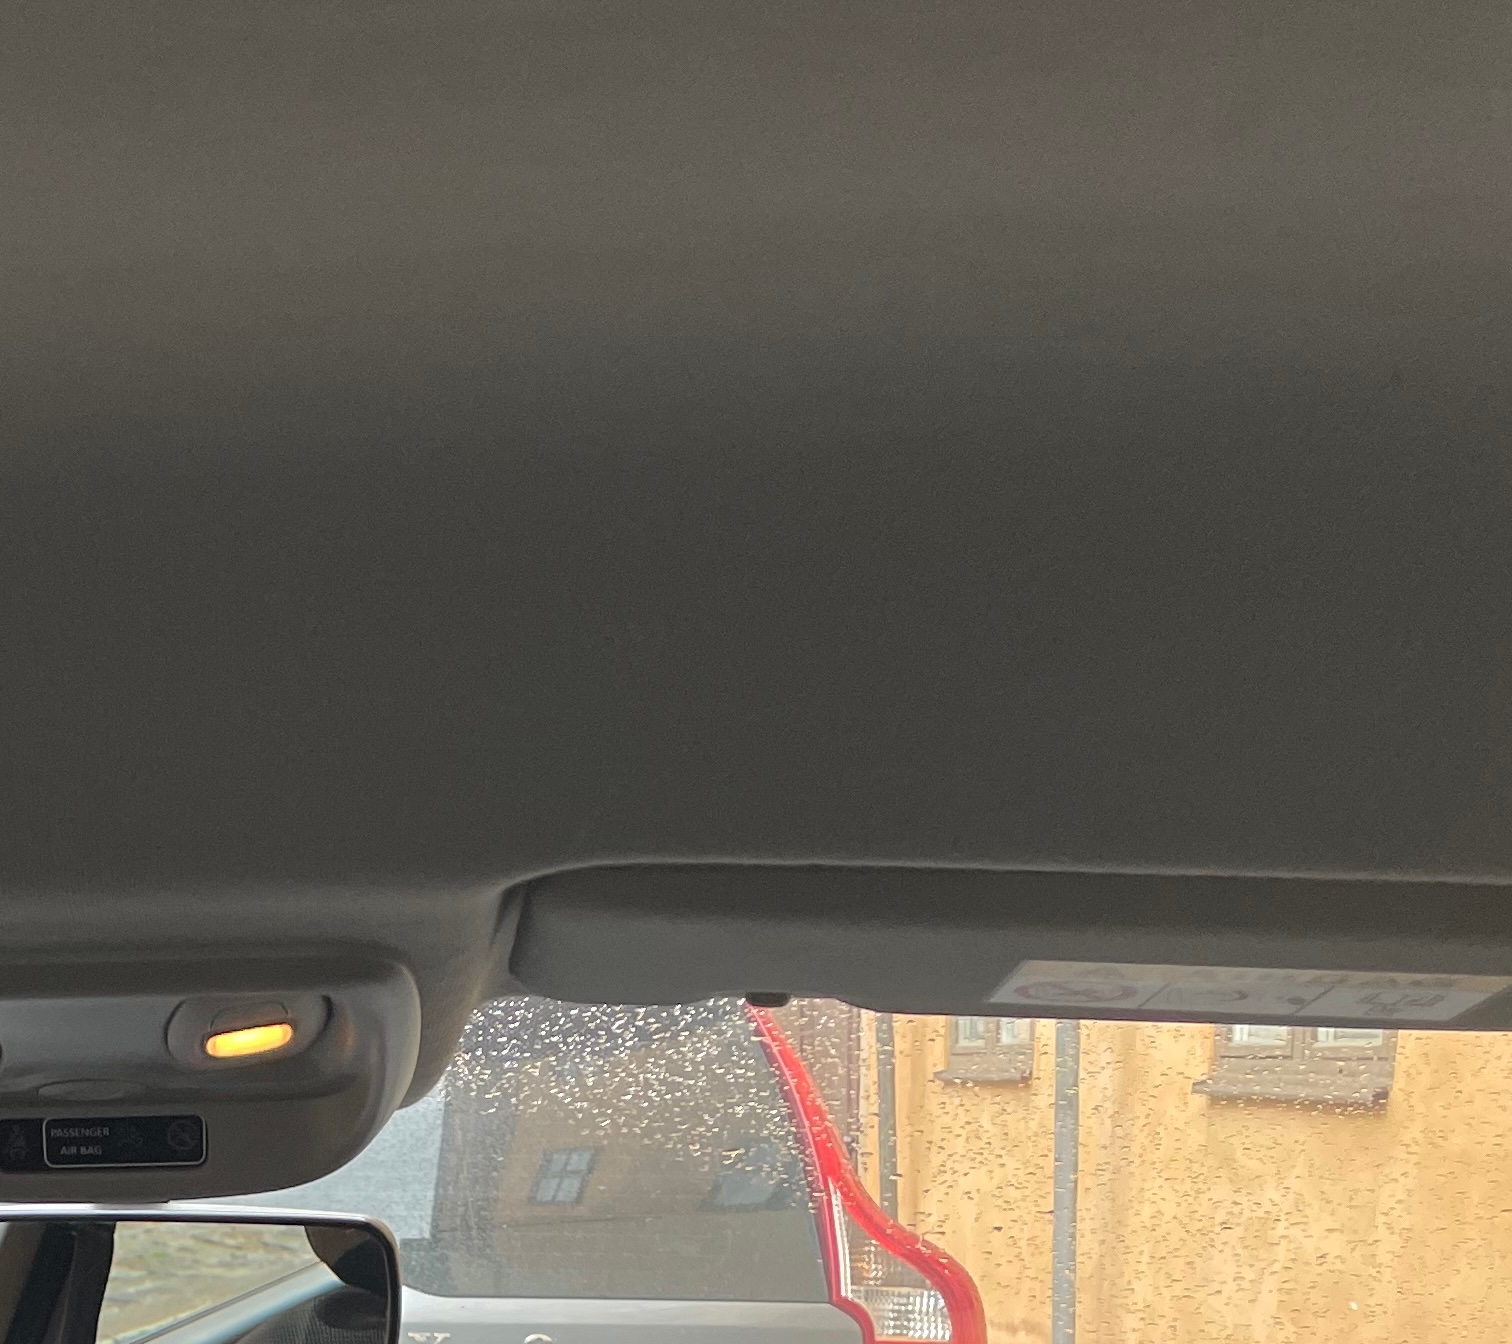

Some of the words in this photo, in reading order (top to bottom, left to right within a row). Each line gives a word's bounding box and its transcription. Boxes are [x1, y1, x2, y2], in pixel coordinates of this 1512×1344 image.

[50, 1126, 110, 1138] PASSENGER
[60, 1145, 77, 1156] AIR
[80, 1145, 103, 1156] BAG
